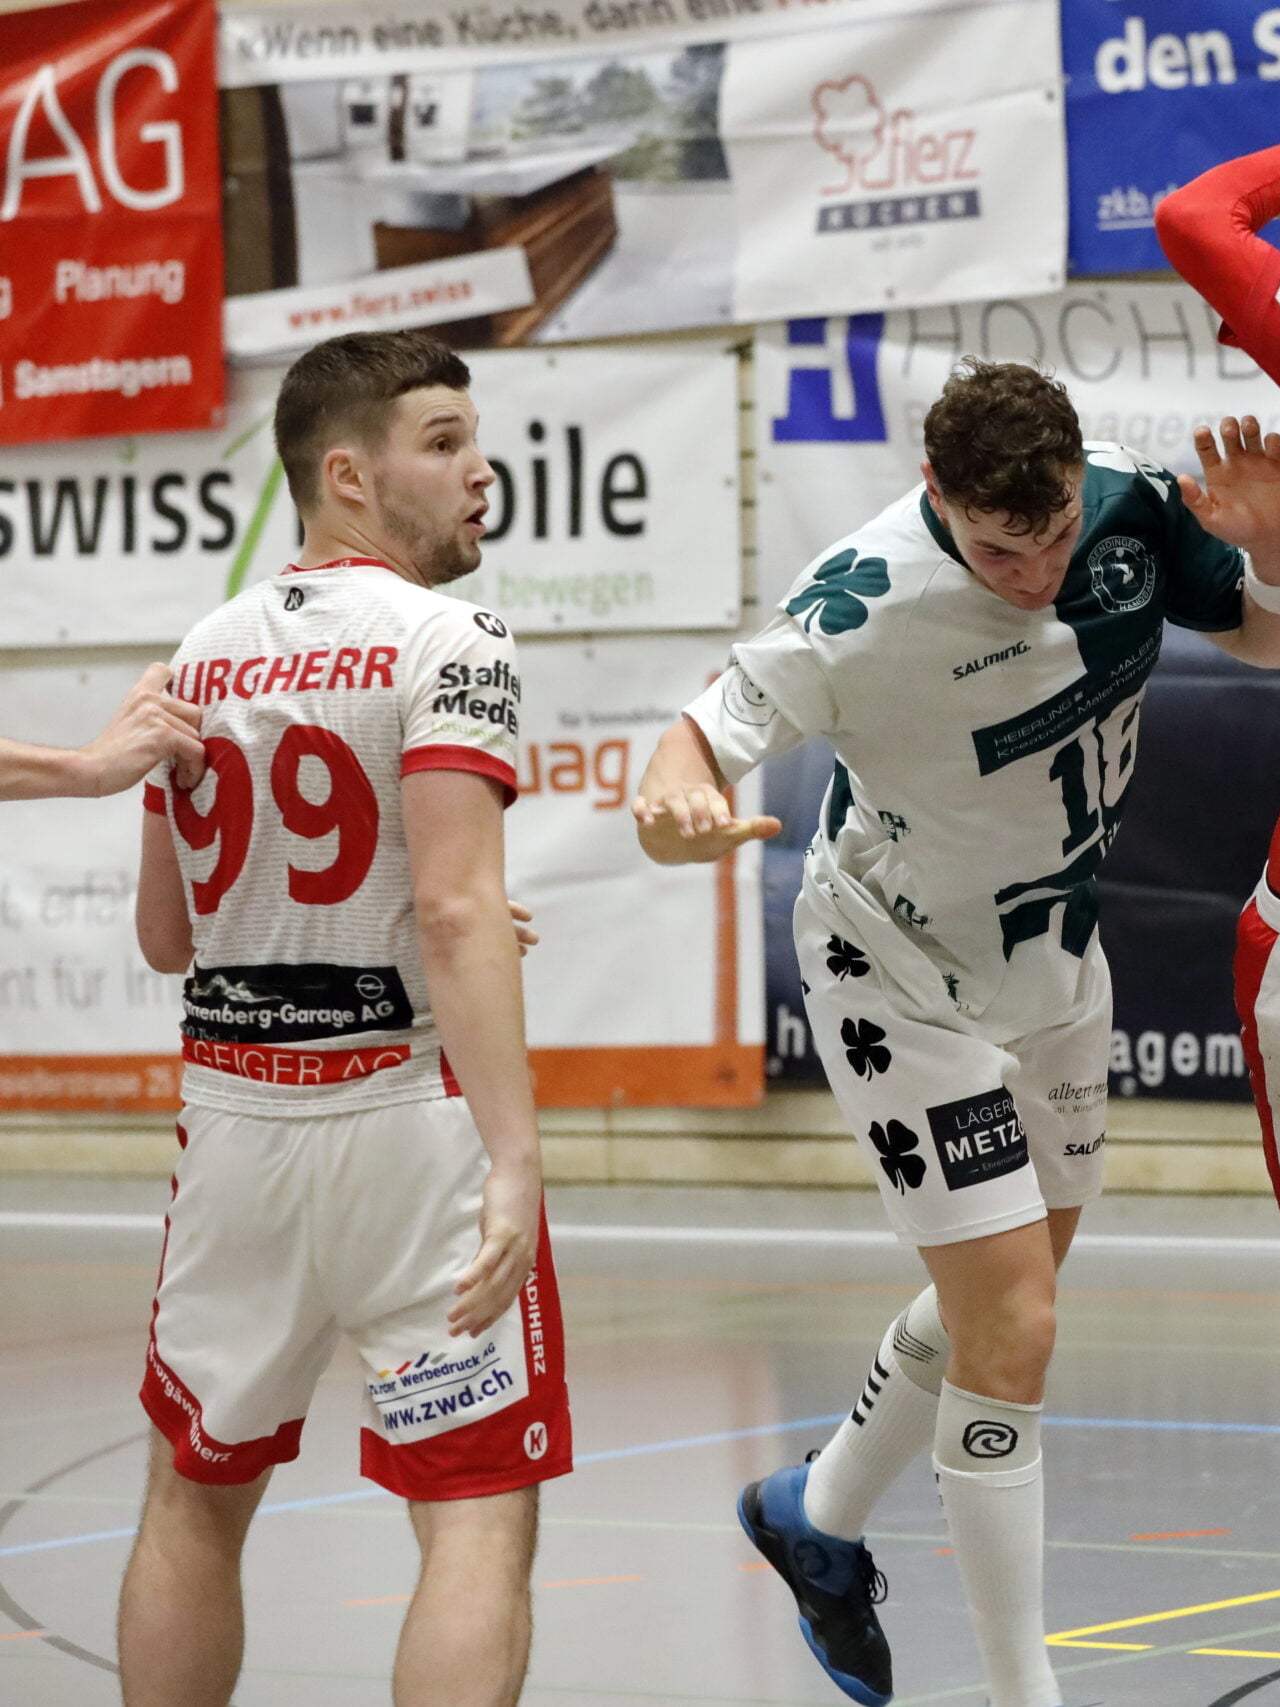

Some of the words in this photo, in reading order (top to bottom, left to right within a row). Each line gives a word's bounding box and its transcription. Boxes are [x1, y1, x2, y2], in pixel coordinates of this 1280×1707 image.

[1097, 17, 1237, 92] den
[1, 47, 186, 221] AG
[56, 258, 185, 304] Planung
[177, 646, 399, 706] URGHERR
[993, 699, 1072, 748] HEIERLING
[1111, 635, 1155, 678] MALER
[169, 724, 380, 918] 99
[361, 1000, 395, 1023] AG
[1048, 1082, 1092, 1101] albert
[399, 1355, 481, 1389] Werbedruck
[482, 1341, 496, 1361] AG
